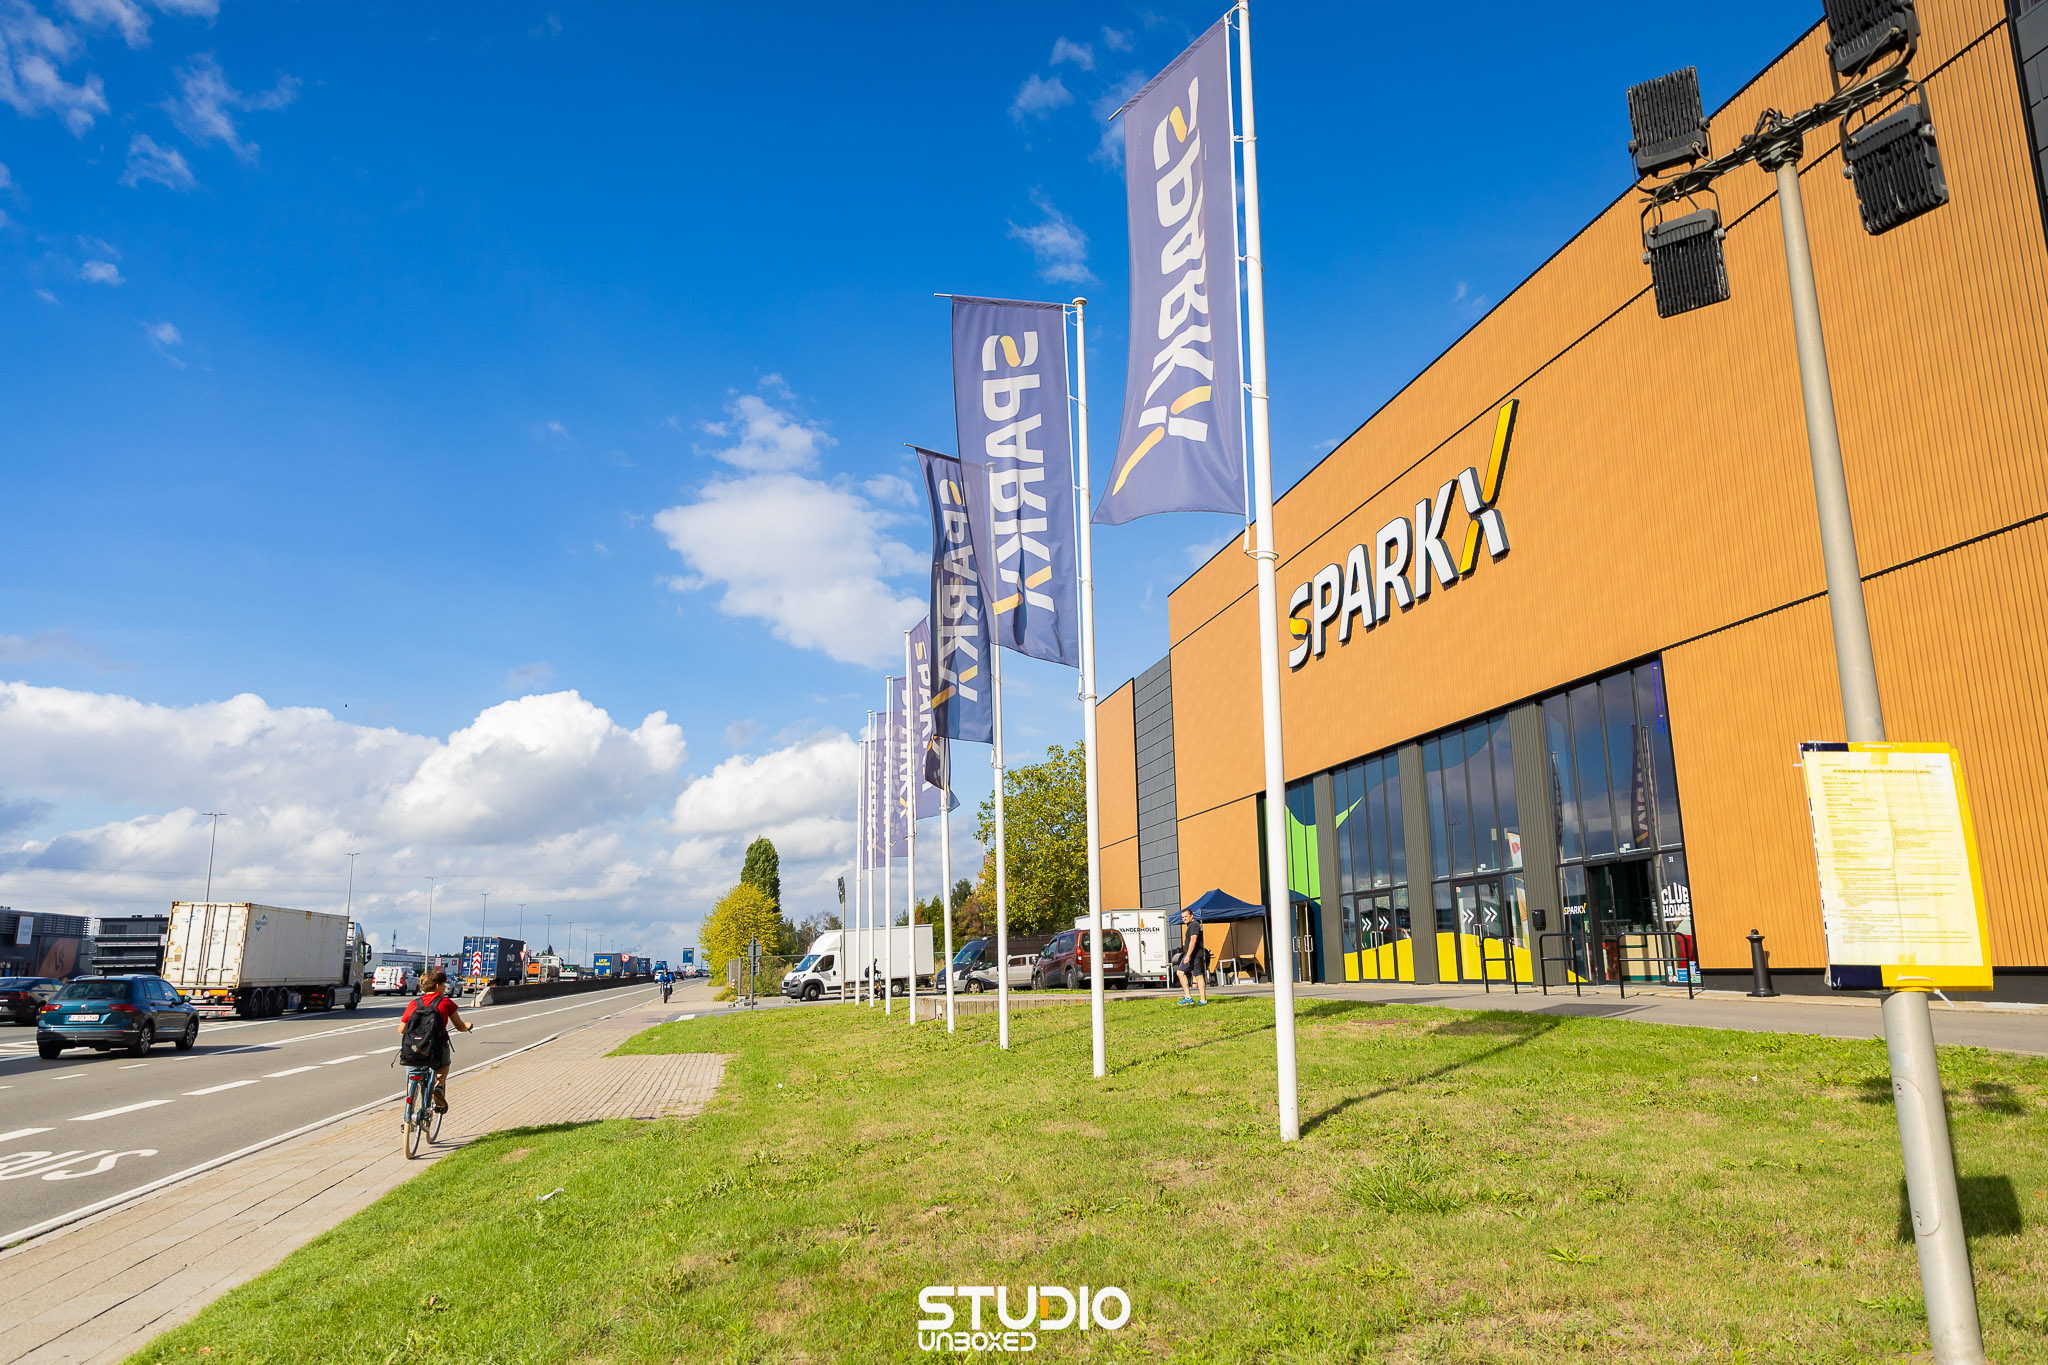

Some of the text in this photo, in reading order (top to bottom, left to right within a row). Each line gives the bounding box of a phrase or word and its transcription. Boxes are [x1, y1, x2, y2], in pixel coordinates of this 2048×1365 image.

[1288, 398, 1520, 669] SPARKX
[1661, 882, 1689, 904] CLUB
[1563, 902, 1586, 915] SPARKX
[1662, 903, 1691, 917] HOUSE
